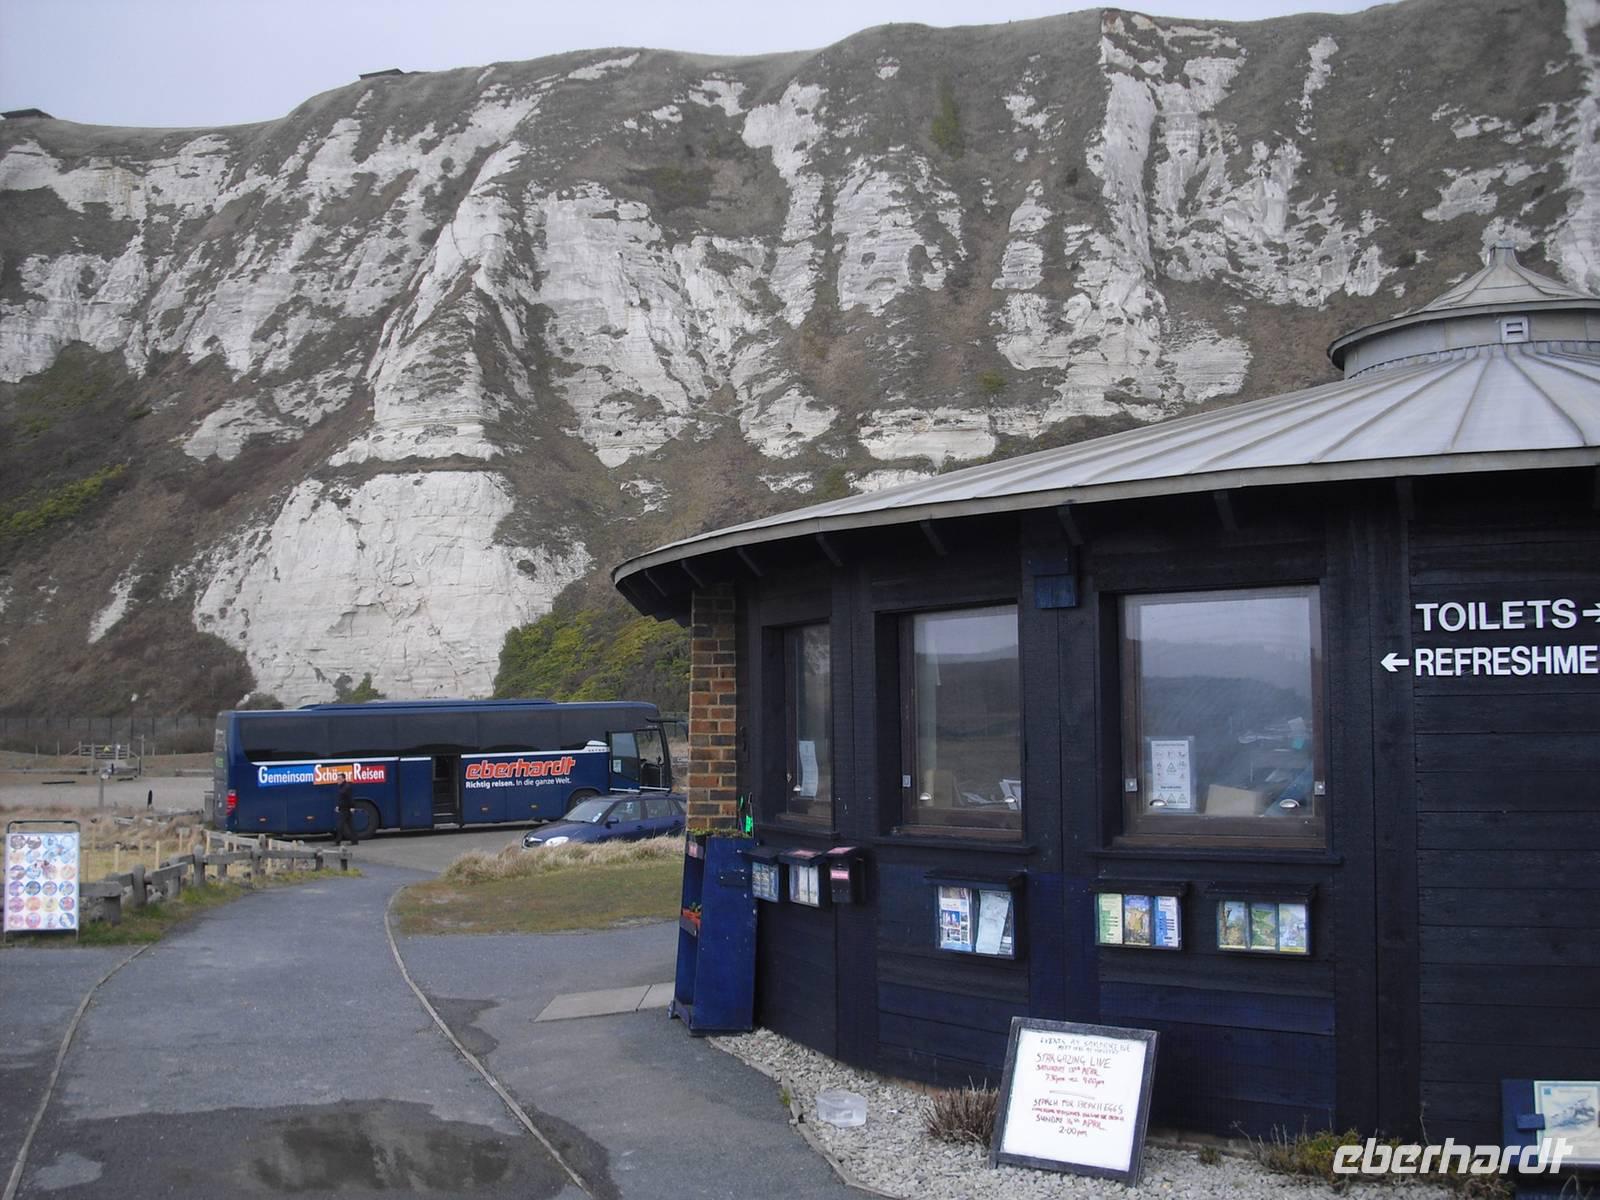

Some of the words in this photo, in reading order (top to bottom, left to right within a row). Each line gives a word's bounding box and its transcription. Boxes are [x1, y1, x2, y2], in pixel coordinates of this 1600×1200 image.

[1415, 599, 1577, 632] TOILETS
[1415, 645, 1599, 676] REFRESHME
[258, 766, 314, 784] Gemeinsam
[353, 763, 385, 780] Reisen
[465, 756, 576, 779] eberhardt
[465, 780, 490, 789] Richtig
[491, 779, 515, 788] reisen.
[524, 778, 534, 786] die
[535, 778, 555, 786] ganze
[1089, 1057, 1112, 1069] LIVE
